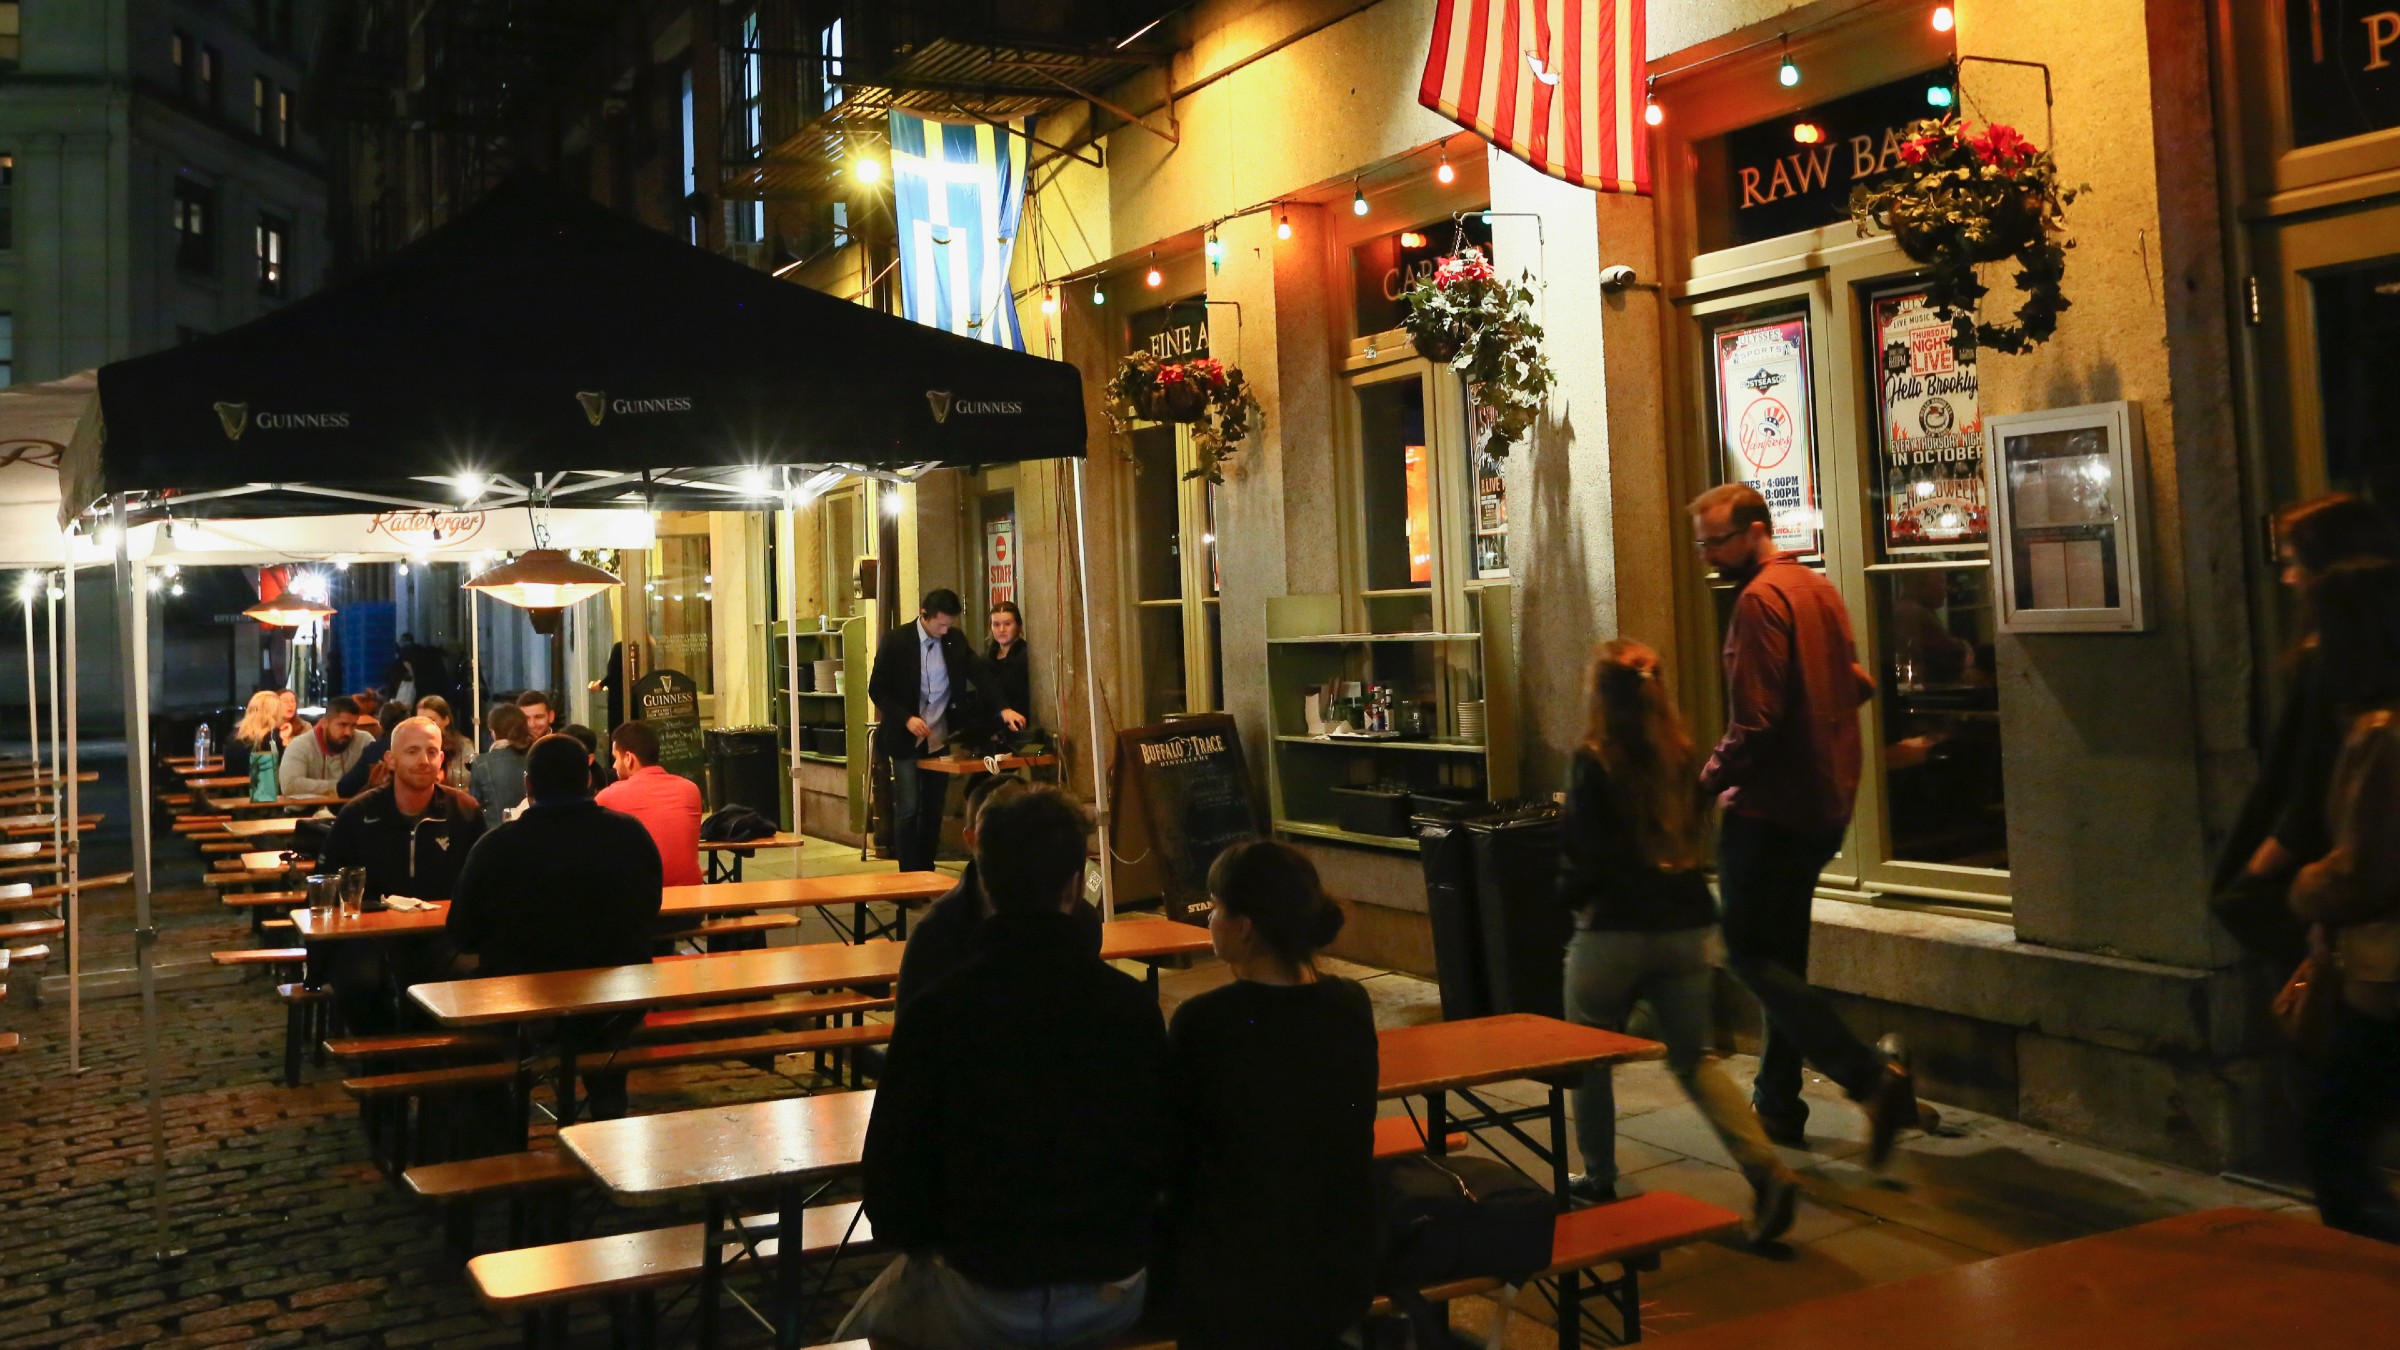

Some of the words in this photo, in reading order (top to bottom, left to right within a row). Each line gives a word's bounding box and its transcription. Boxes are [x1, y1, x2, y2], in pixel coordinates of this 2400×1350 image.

[1738, 143, 1838, 209] RAW
[1848, 127, 1908, 180] BA
[1893, 319, 1907, 329] LIVE
[1909, 313, 1930, 325] MUSIC
[1740, 329, 1780, 345] ULYSSES
[1912, 327, 1950, 339] THURSDAY
[1149, 325, 1192, 359] FINE
[1912, 336, 1950, 353] NIGHT
[1740, 345, 1782, 358] SPORTS
[1914, 350, 1952, 373] LIVE
[1885, 373, 1923, 408] Hello
[613, 397, 692, 414] GUINNESS
[955, 399, 1022, 414] GUINNESS
[256, 412, 350, 429] GUINNESS
[1742, 423, 1792, 455] Yankees
[1892, 438, 1916, 453] EVERY
[1917, 434, 1960, 451] THURSDAY
[1893, 452, 1908, 467] IN
[1767, 476, 1799, 488] 4:00PM
[1765, 487, 1799, 500] 8:00PM
[367, 510, 479, 537] Radeberger
[991, 564, 1011, 584] STAFF
[643, 692, 693, 707] GUINNESS
[1140, 739, 1184, 764] BUFFALO
[1190, 735, 1226, 757] TRACE
[1160, 755, 1210, 767] DISTILLERY
